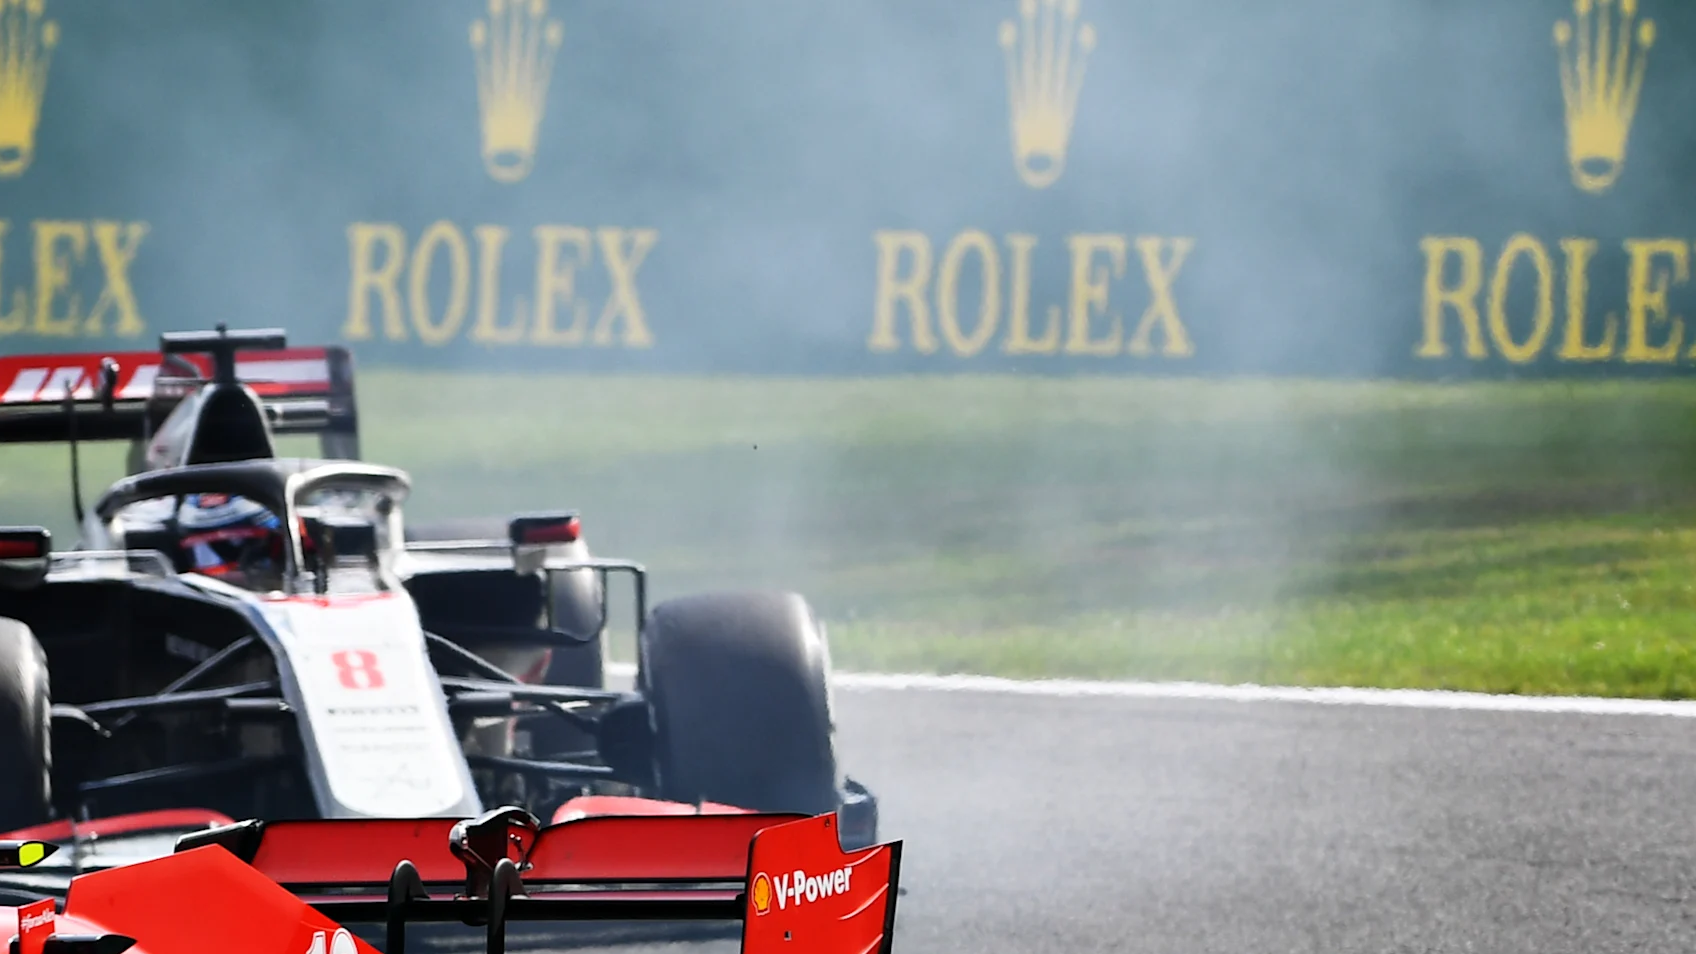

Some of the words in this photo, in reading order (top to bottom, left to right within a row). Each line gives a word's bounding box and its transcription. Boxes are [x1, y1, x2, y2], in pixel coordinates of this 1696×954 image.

[343, 221, 659, 347] ROLEX
[868, 230, 1195, 357] ROLEX
[1415, 233, 1696, 362] ROLE
[332, 650, 385, 690] 8
[773, 866, 853, 910] V-Power
